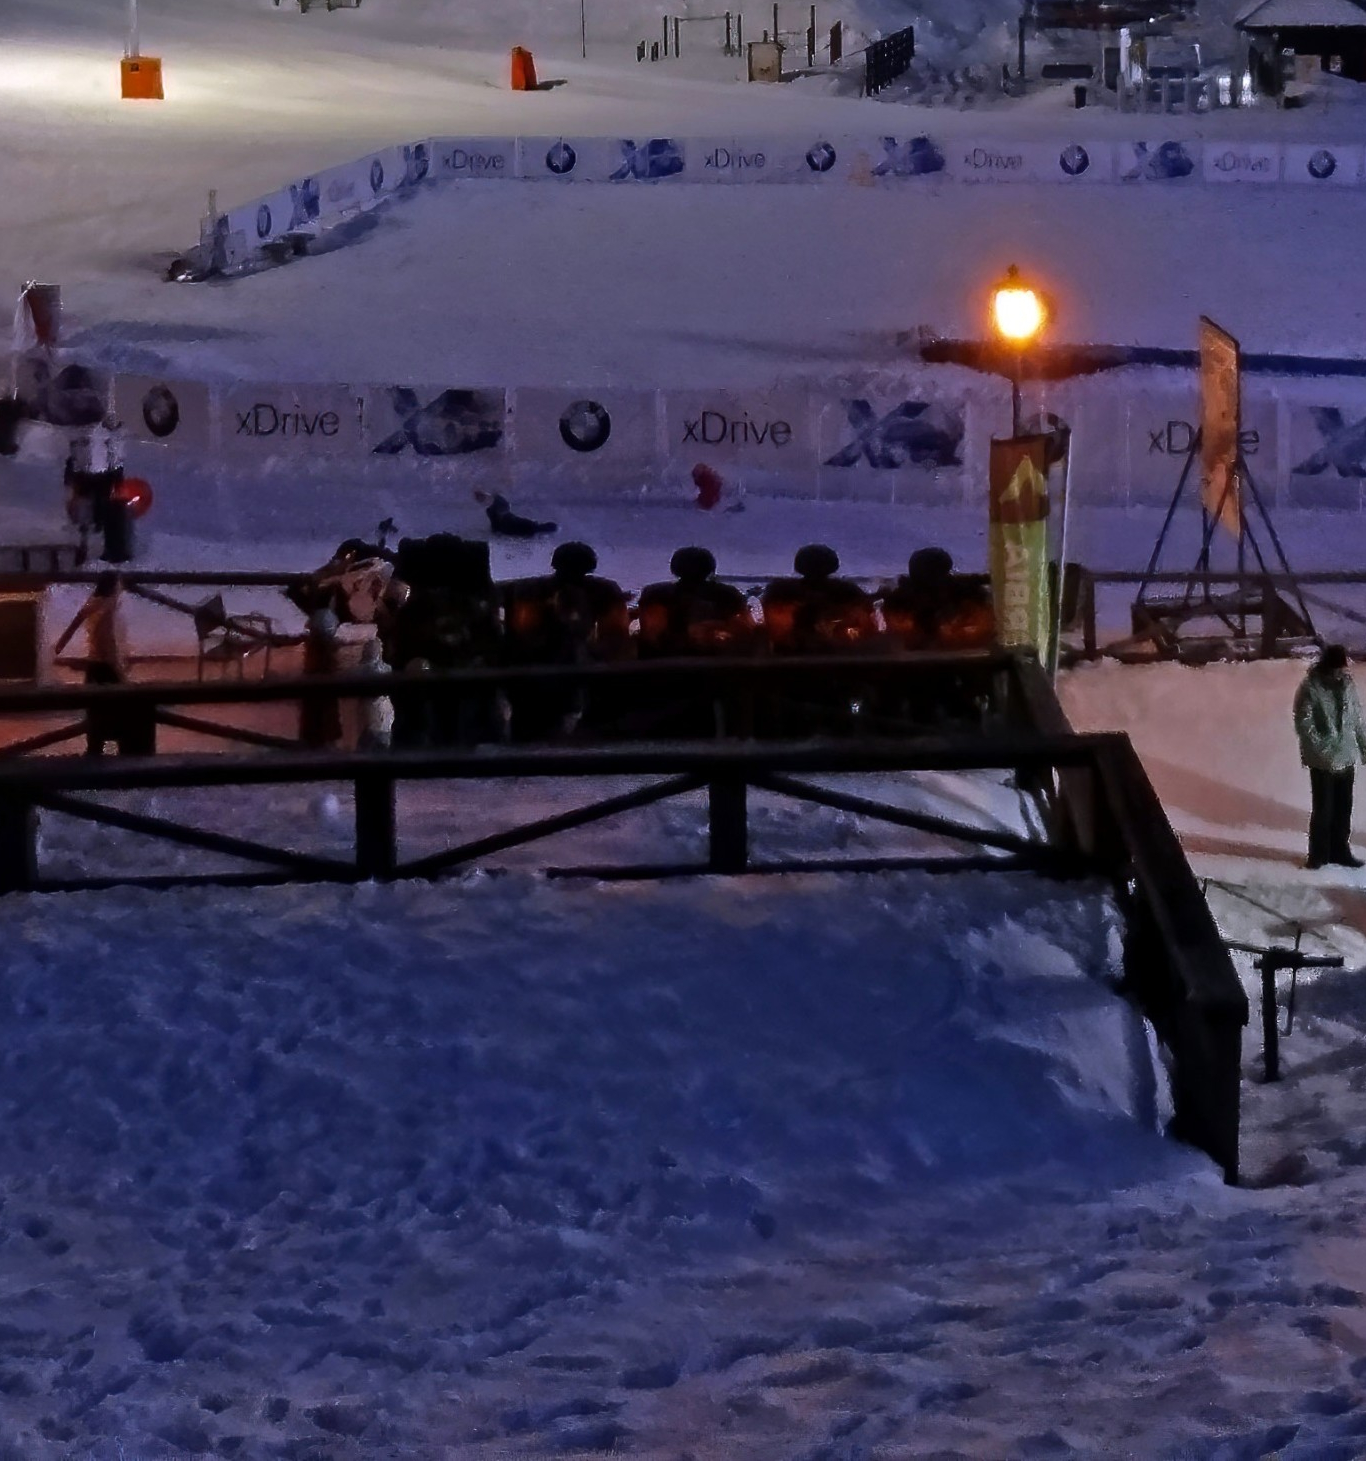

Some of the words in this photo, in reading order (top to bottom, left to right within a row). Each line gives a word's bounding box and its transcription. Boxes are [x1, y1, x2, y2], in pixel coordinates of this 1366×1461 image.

[235, 402, 341, 438] xDrive
[681, 410, 792, 446] xDrive
[1147, 420, 1260, 454] xDe
